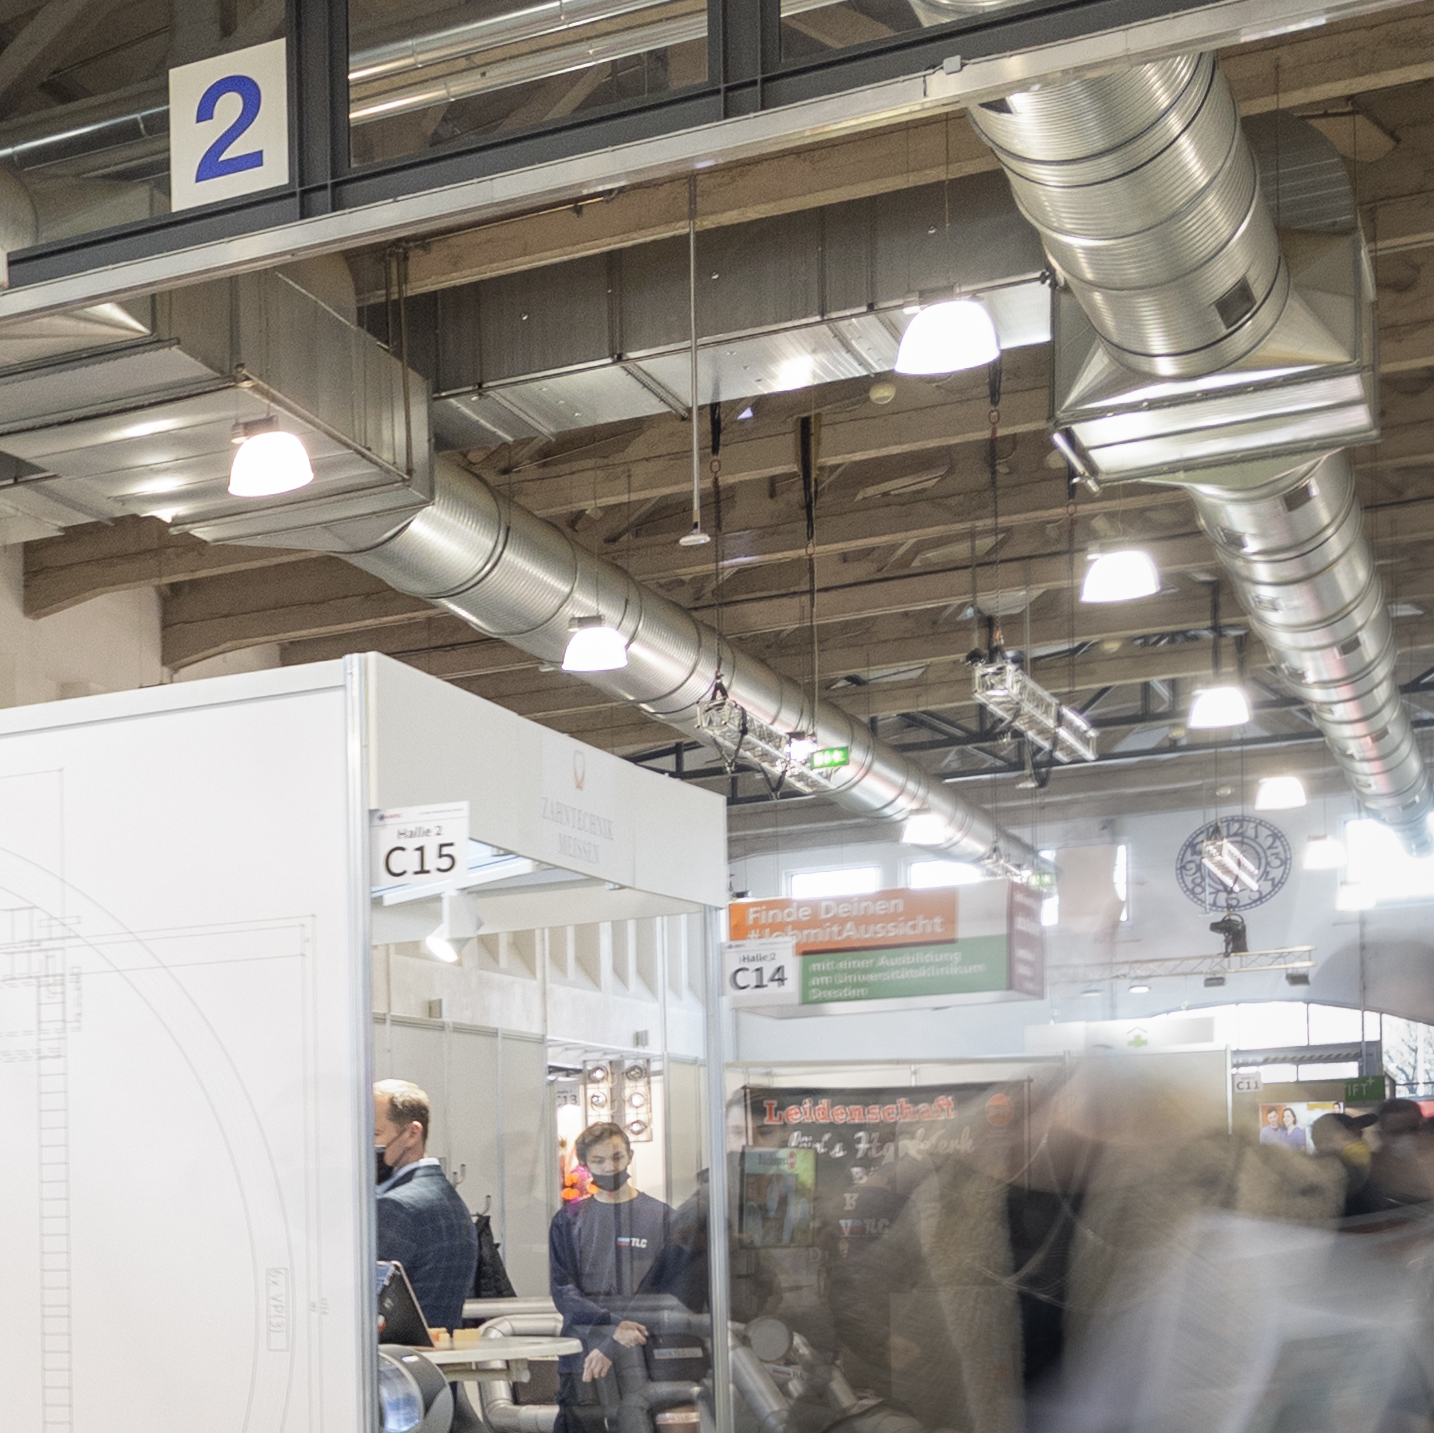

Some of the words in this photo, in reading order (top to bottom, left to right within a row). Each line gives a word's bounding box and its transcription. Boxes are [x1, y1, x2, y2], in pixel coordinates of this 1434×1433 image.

[194, 73, 264, 184] 2
[384, 842, 456, 878] C15
[746, 903, 812, 926] Finde
[819, 896, 905, 920] Deinen
[729, 964, 788, 991] C14
[1236, 1081, 1260, 1091] C11
[763, 1094, 959, 1125] Leidenschaft
